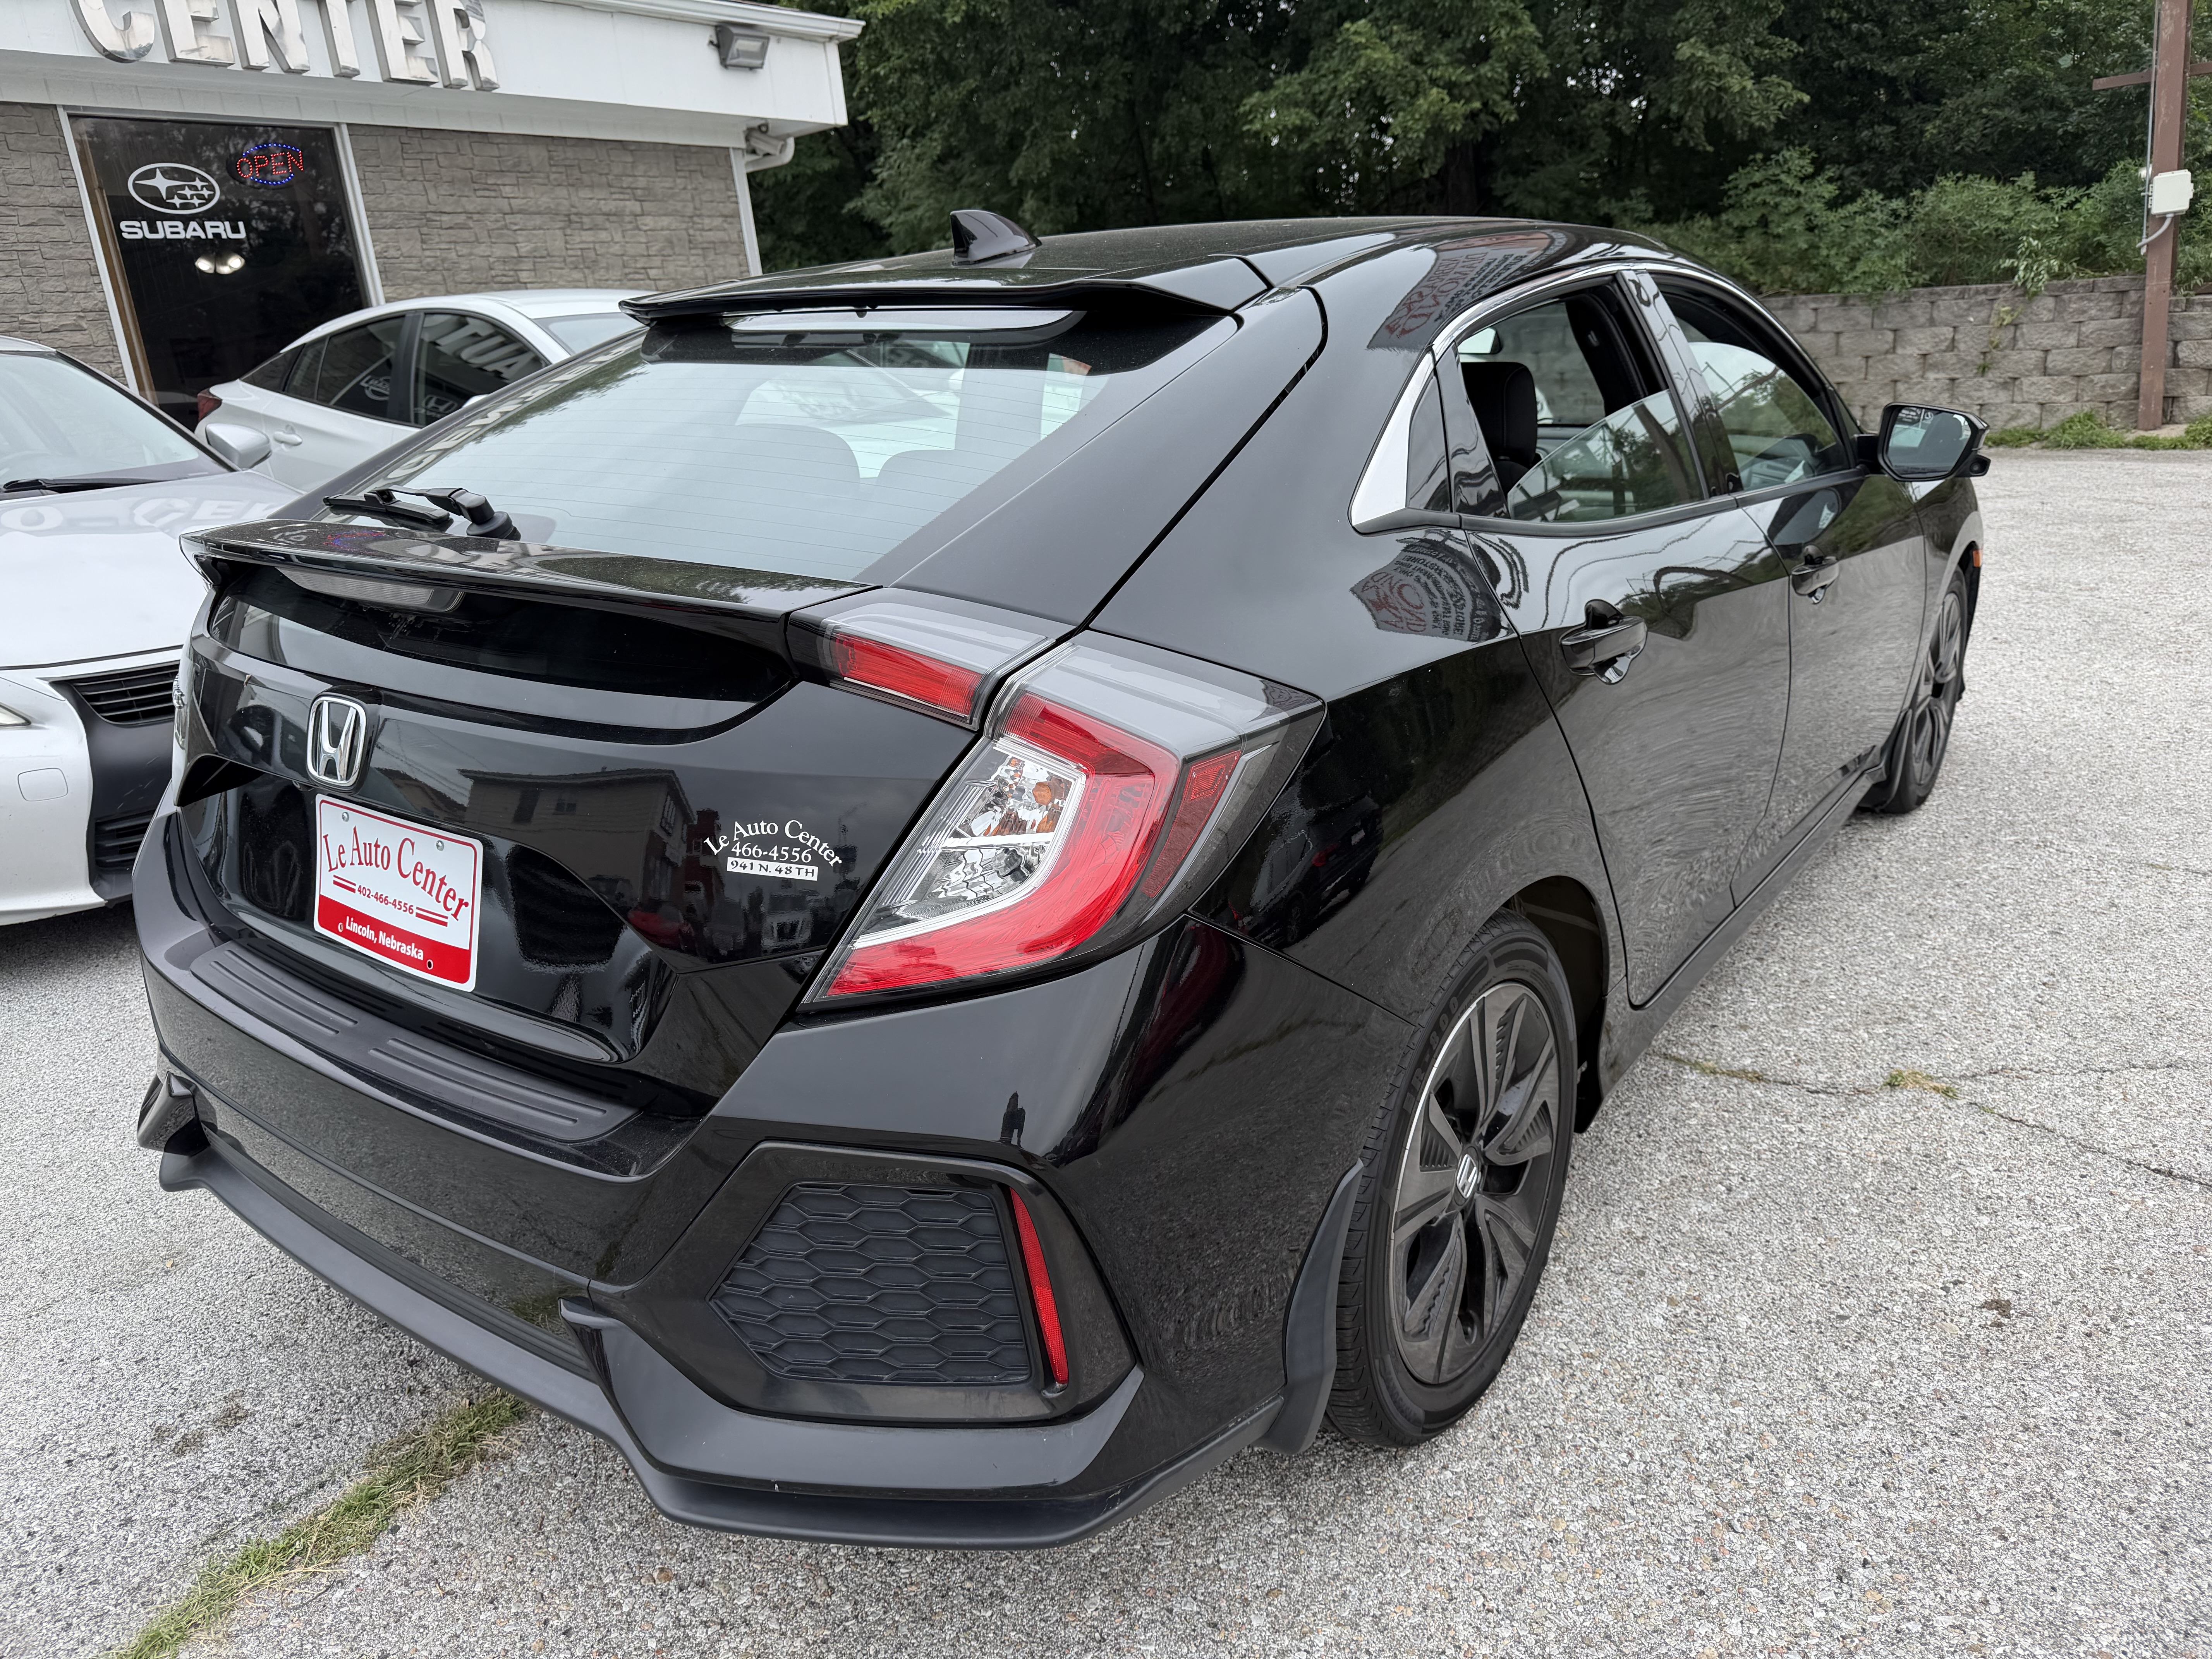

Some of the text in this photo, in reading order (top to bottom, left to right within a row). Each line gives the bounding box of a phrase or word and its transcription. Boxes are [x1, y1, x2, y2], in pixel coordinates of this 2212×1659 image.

[236, 150, 304, 178] OPEN
[120, 221, 246, 240] SUBARU
[704, 820, 842, 867] Le Auto Center
[732, 841, 812, 863] 466-4556
[323, 826, 469, 921] Le Auto Center
[731, 860, 754, 870] 941
[758, 863, 771, 873] N.
[357, 885, 414, 914] 402-466-4556
[346, 916, 424, 960] Lincoln, Nebraska
